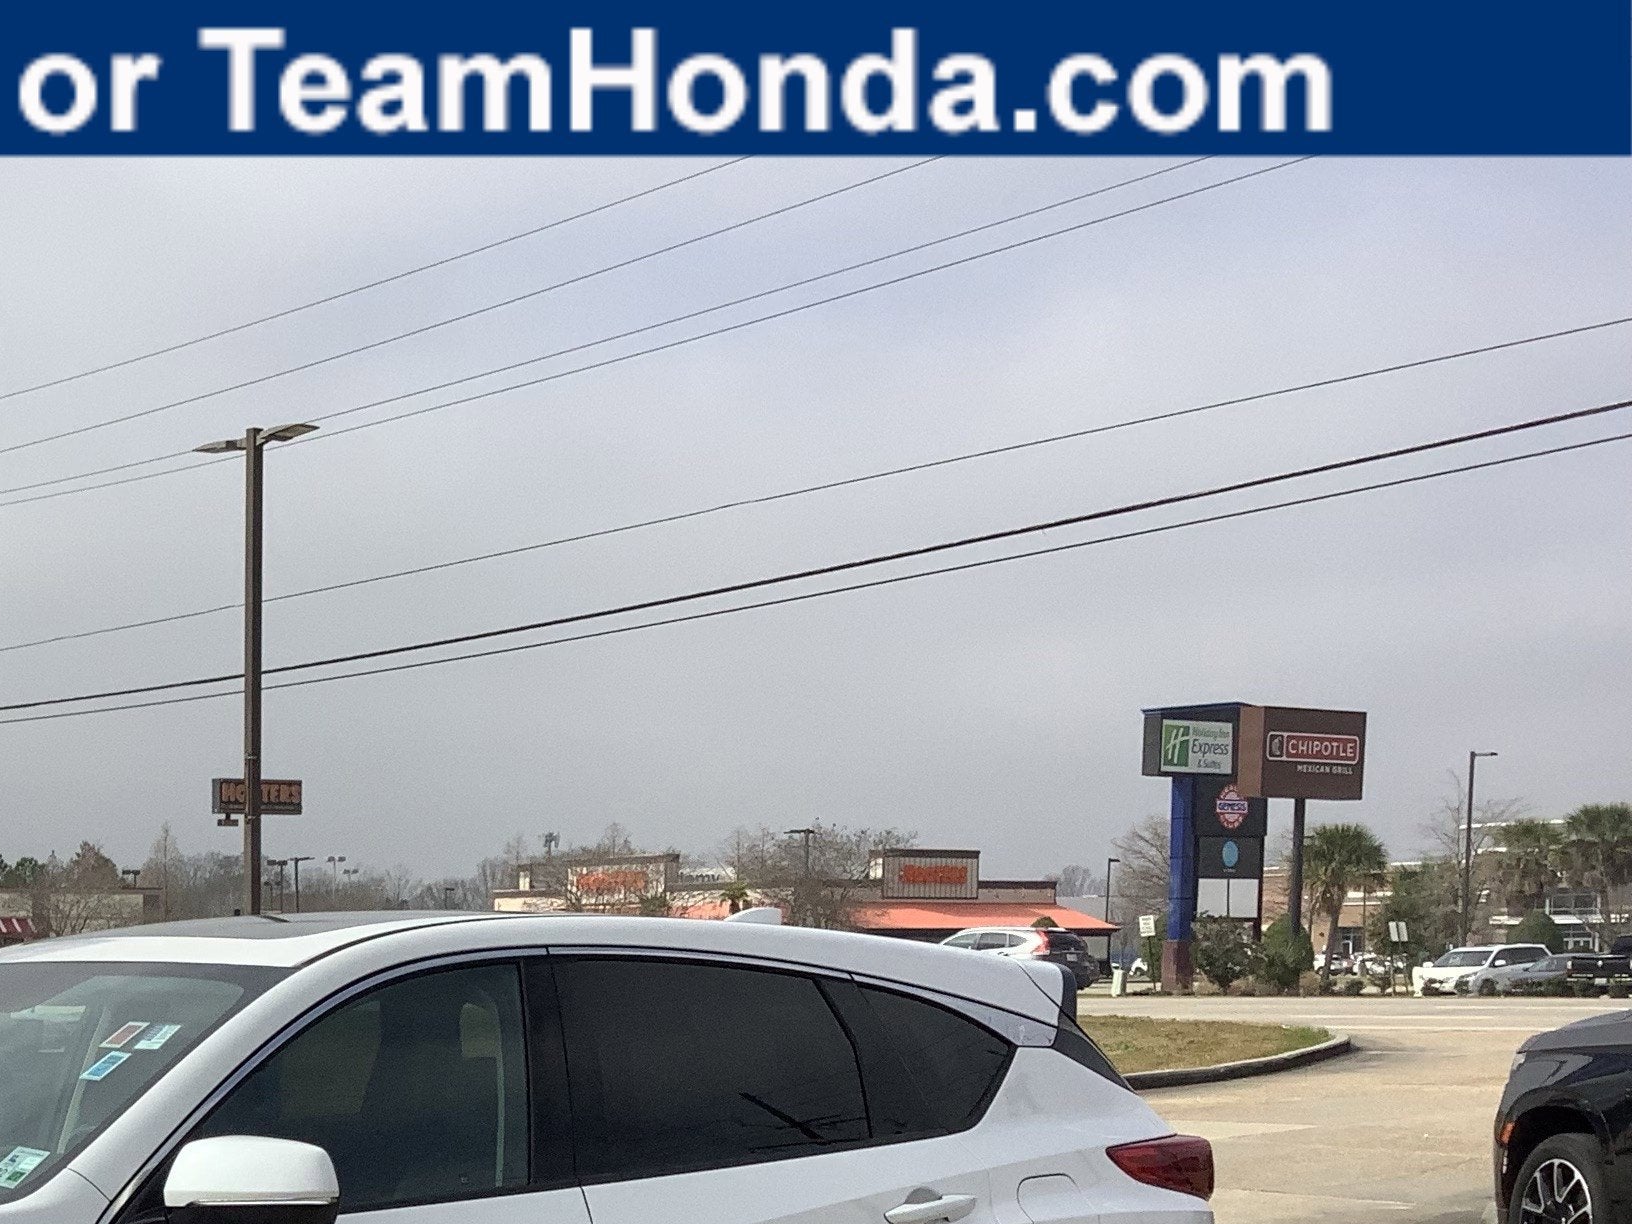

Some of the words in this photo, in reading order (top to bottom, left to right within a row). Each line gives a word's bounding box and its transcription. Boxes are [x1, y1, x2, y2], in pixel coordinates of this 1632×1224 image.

[1192, 738, 1229, 758] Express
[1288, 739, 1355, 757] CHIPOTLE
[1297, 764, 1330, 773] MEXICAN
[1332, 766, 1353, 775] GRILL
[221, 782, 301, 803] HOTERS
